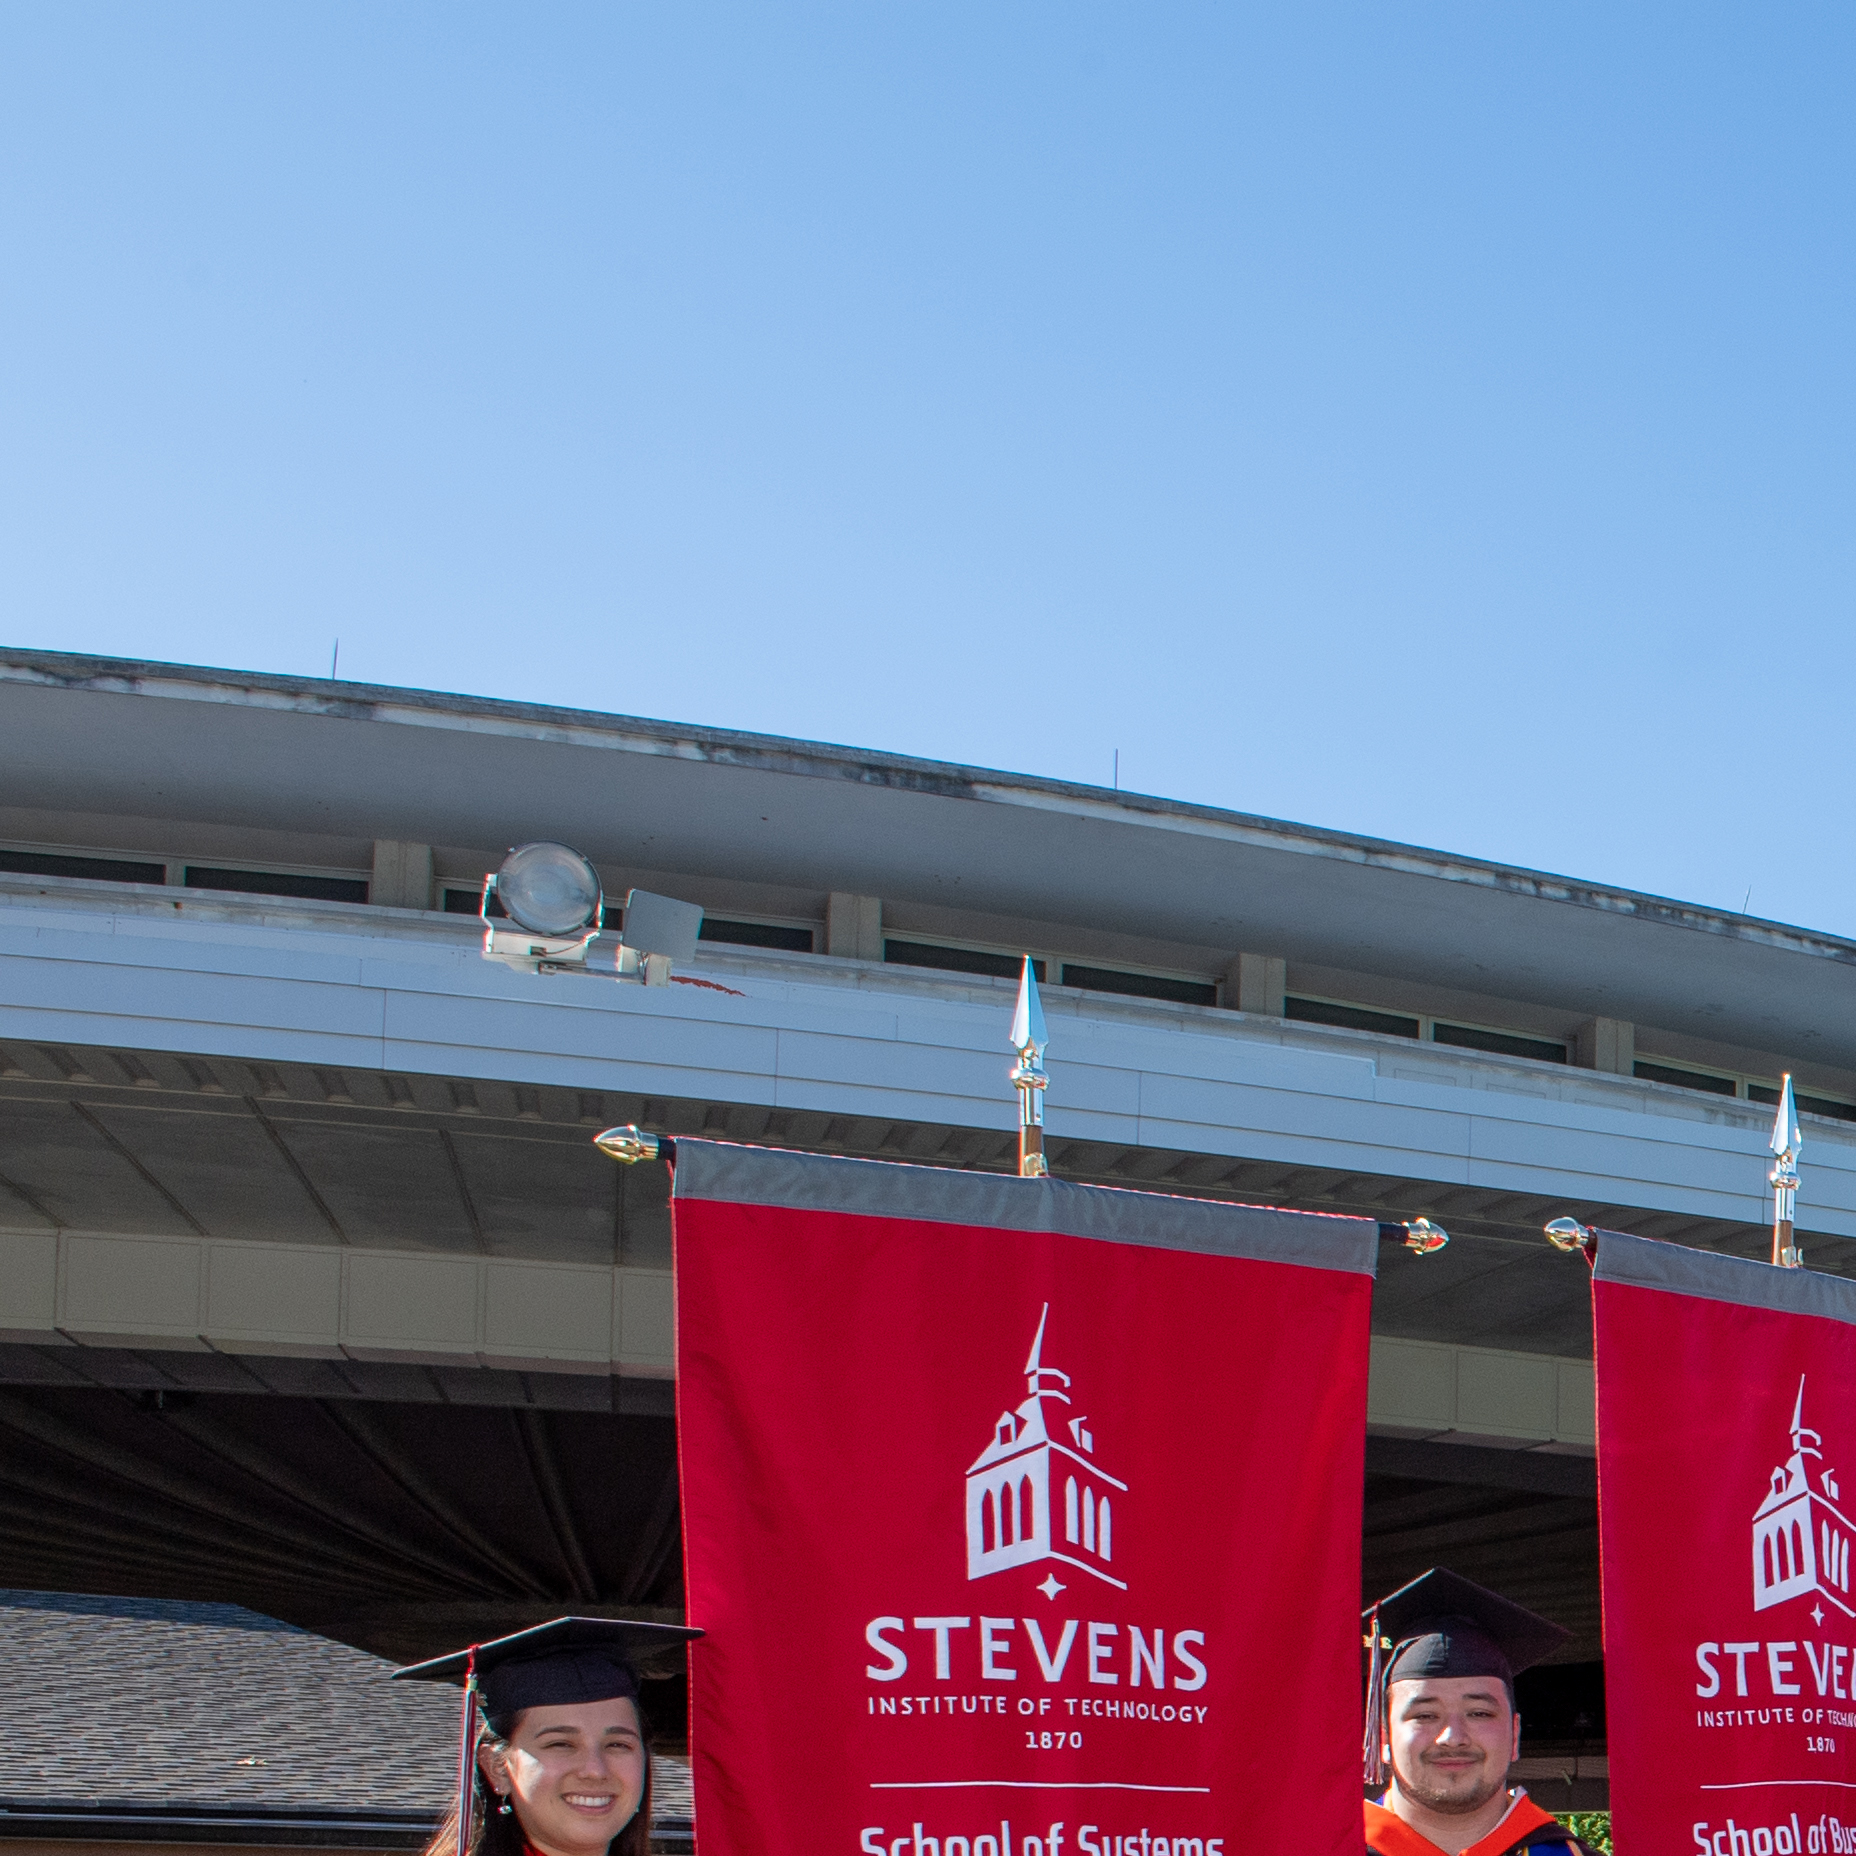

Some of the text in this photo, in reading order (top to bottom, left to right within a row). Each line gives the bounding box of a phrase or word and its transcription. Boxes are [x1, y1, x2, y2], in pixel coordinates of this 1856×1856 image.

[865, 1615, 1208, 1692] STEVENS
[868, 1695, 1208, 1724] INSTITUTE OF TECHNOLOGY
[1697, 1707, 1795, 1727] INSTITUTE
[1801, 1708, 1824, 1725] OF
[1025, 1730, 1083, 1751] 1870
[1806, 1736, 1836, 1754] 1870
[1807, 1813, 1828, 1855] of
